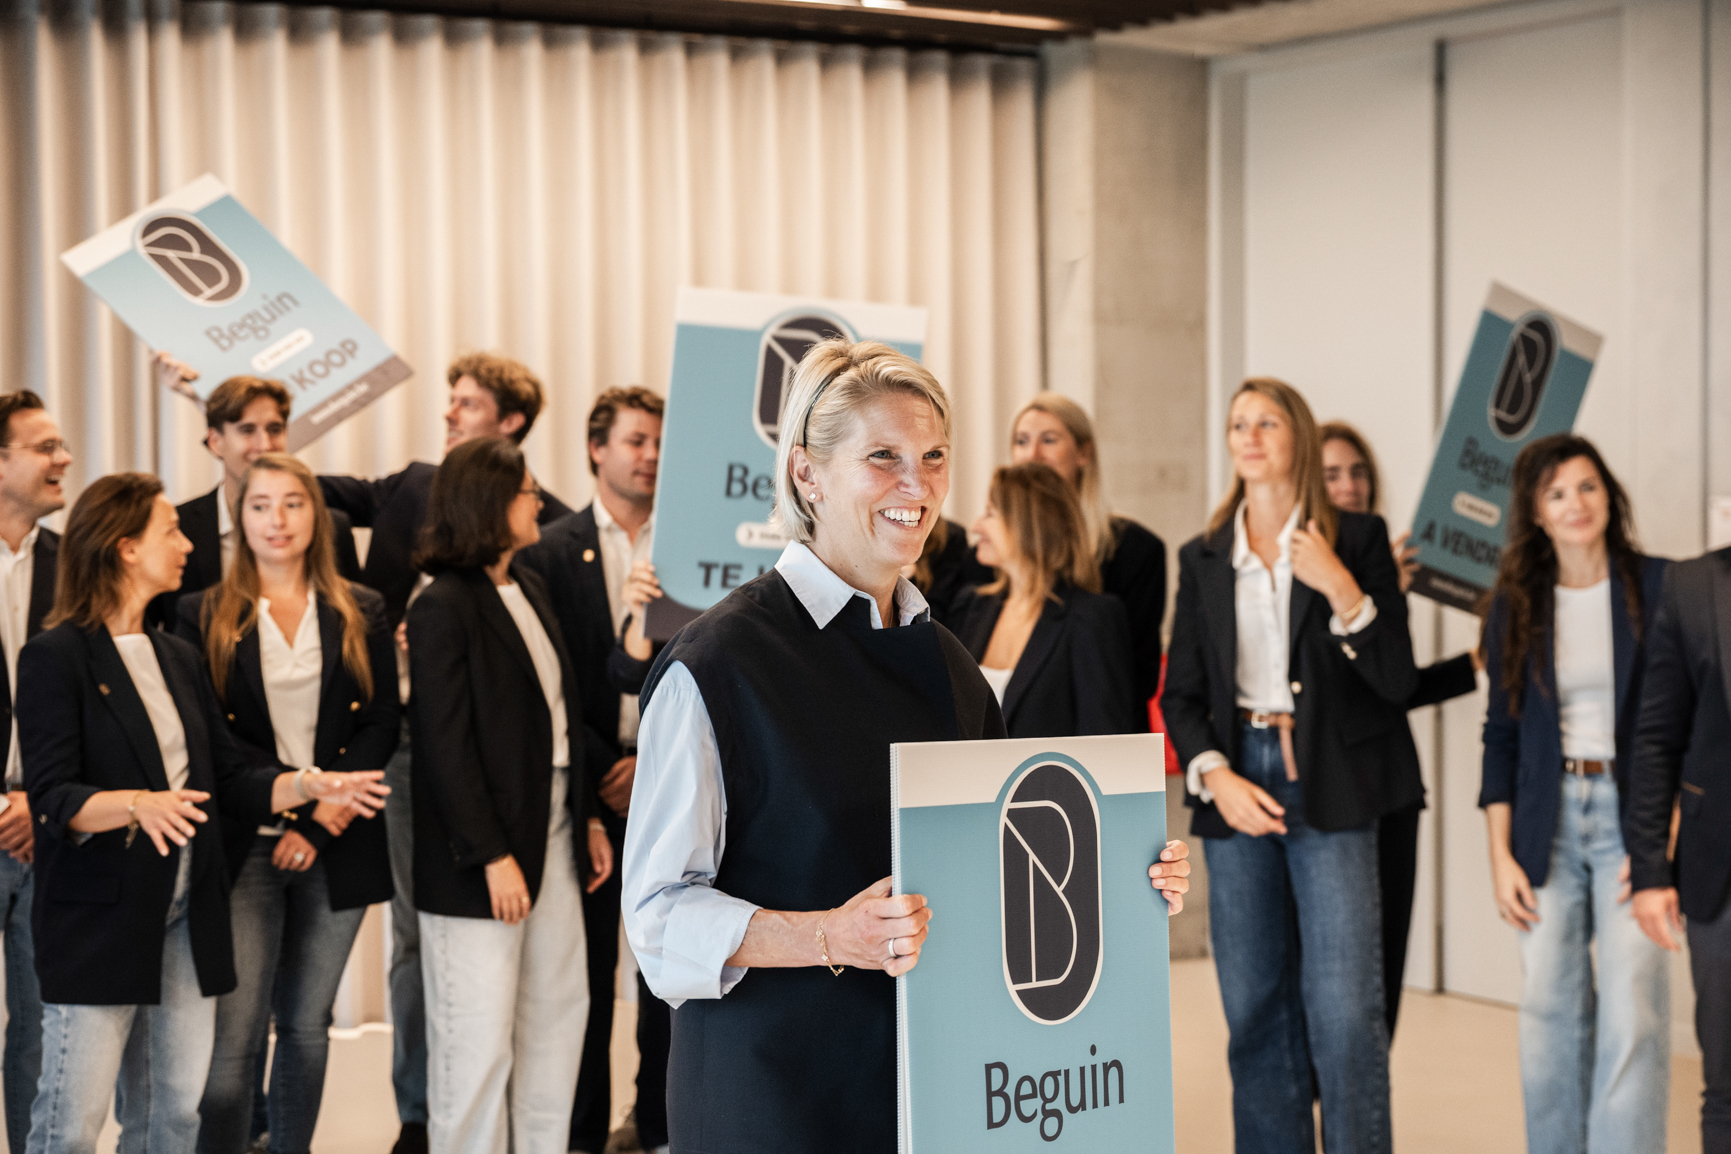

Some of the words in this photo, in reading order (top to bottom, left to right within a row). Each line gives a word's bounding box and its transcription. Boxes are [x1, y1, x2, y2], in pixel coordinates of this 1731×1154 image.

[204, 291, 300, 353] Beguin
[290, 338, 358, 391] KOOP
[725, 462, 776, 501] Be
[1458, 435, 1512, 491] Begu
[1440, 525, 1501, 568] VENDR
[698, 561, 743, 589] TE
[984, 1043, 1125, 1142] Beguin
